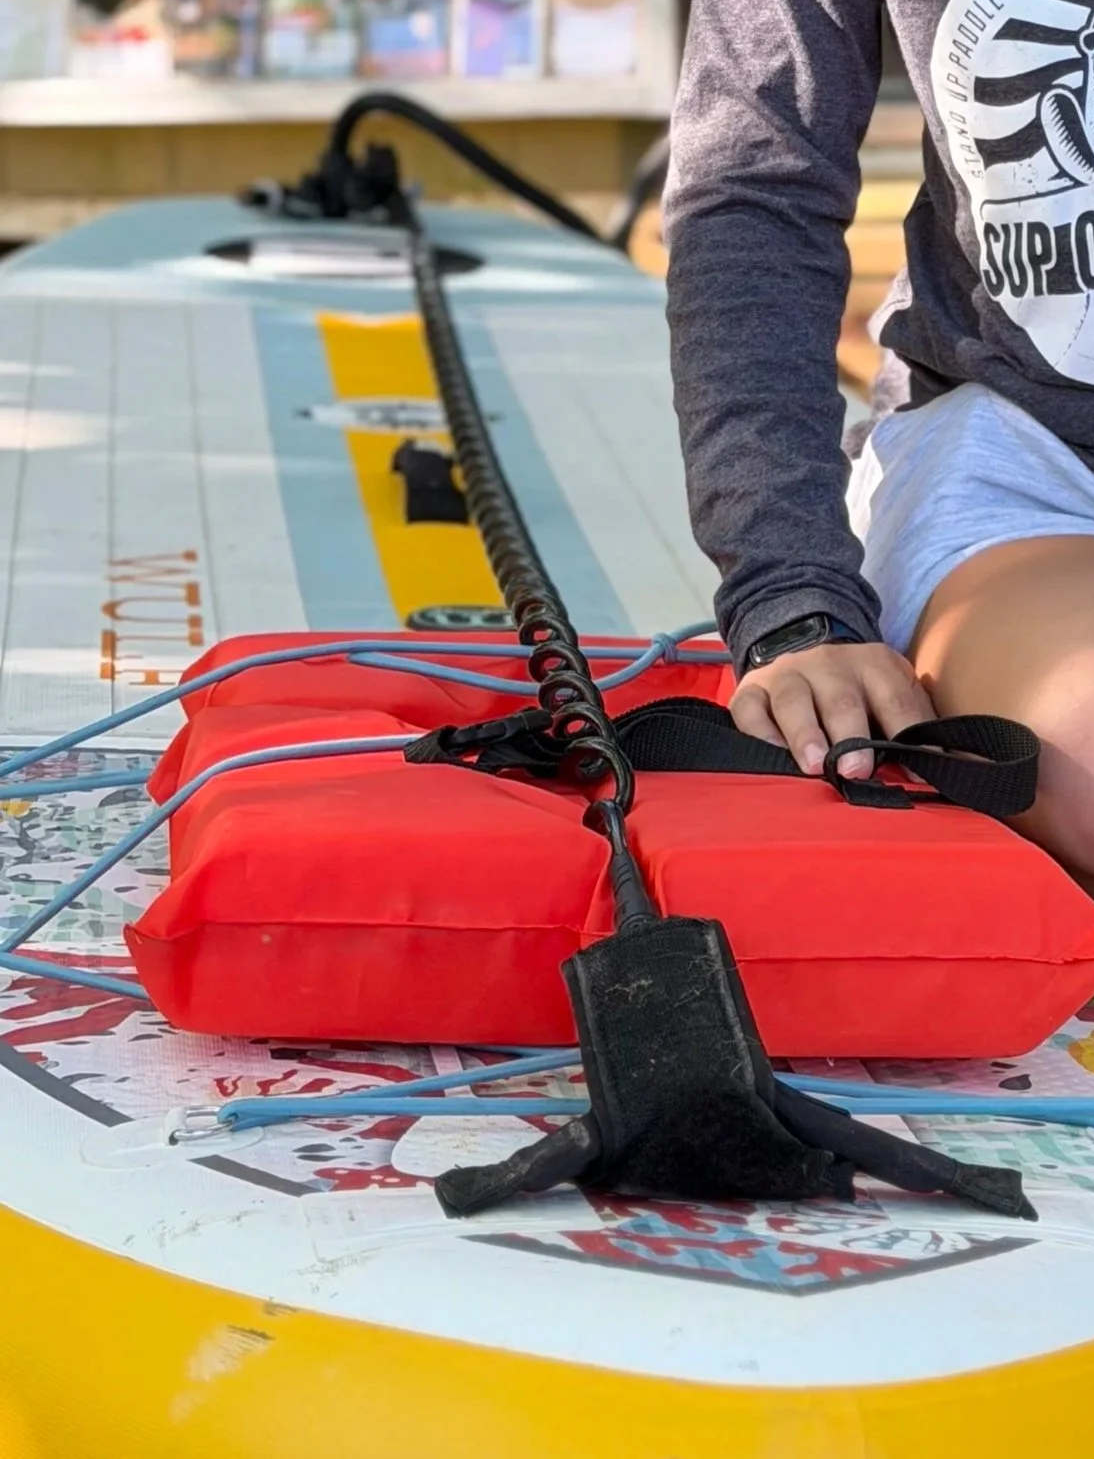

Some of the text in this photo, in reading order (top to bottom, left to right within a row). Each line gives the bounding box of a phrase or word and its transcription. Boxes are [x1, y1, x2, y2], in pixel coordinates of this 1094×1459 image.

[945, 76, 969, 103] UP
[947, 107, 986, 180] STAND
[981, 219, 1055, 299] SUP
